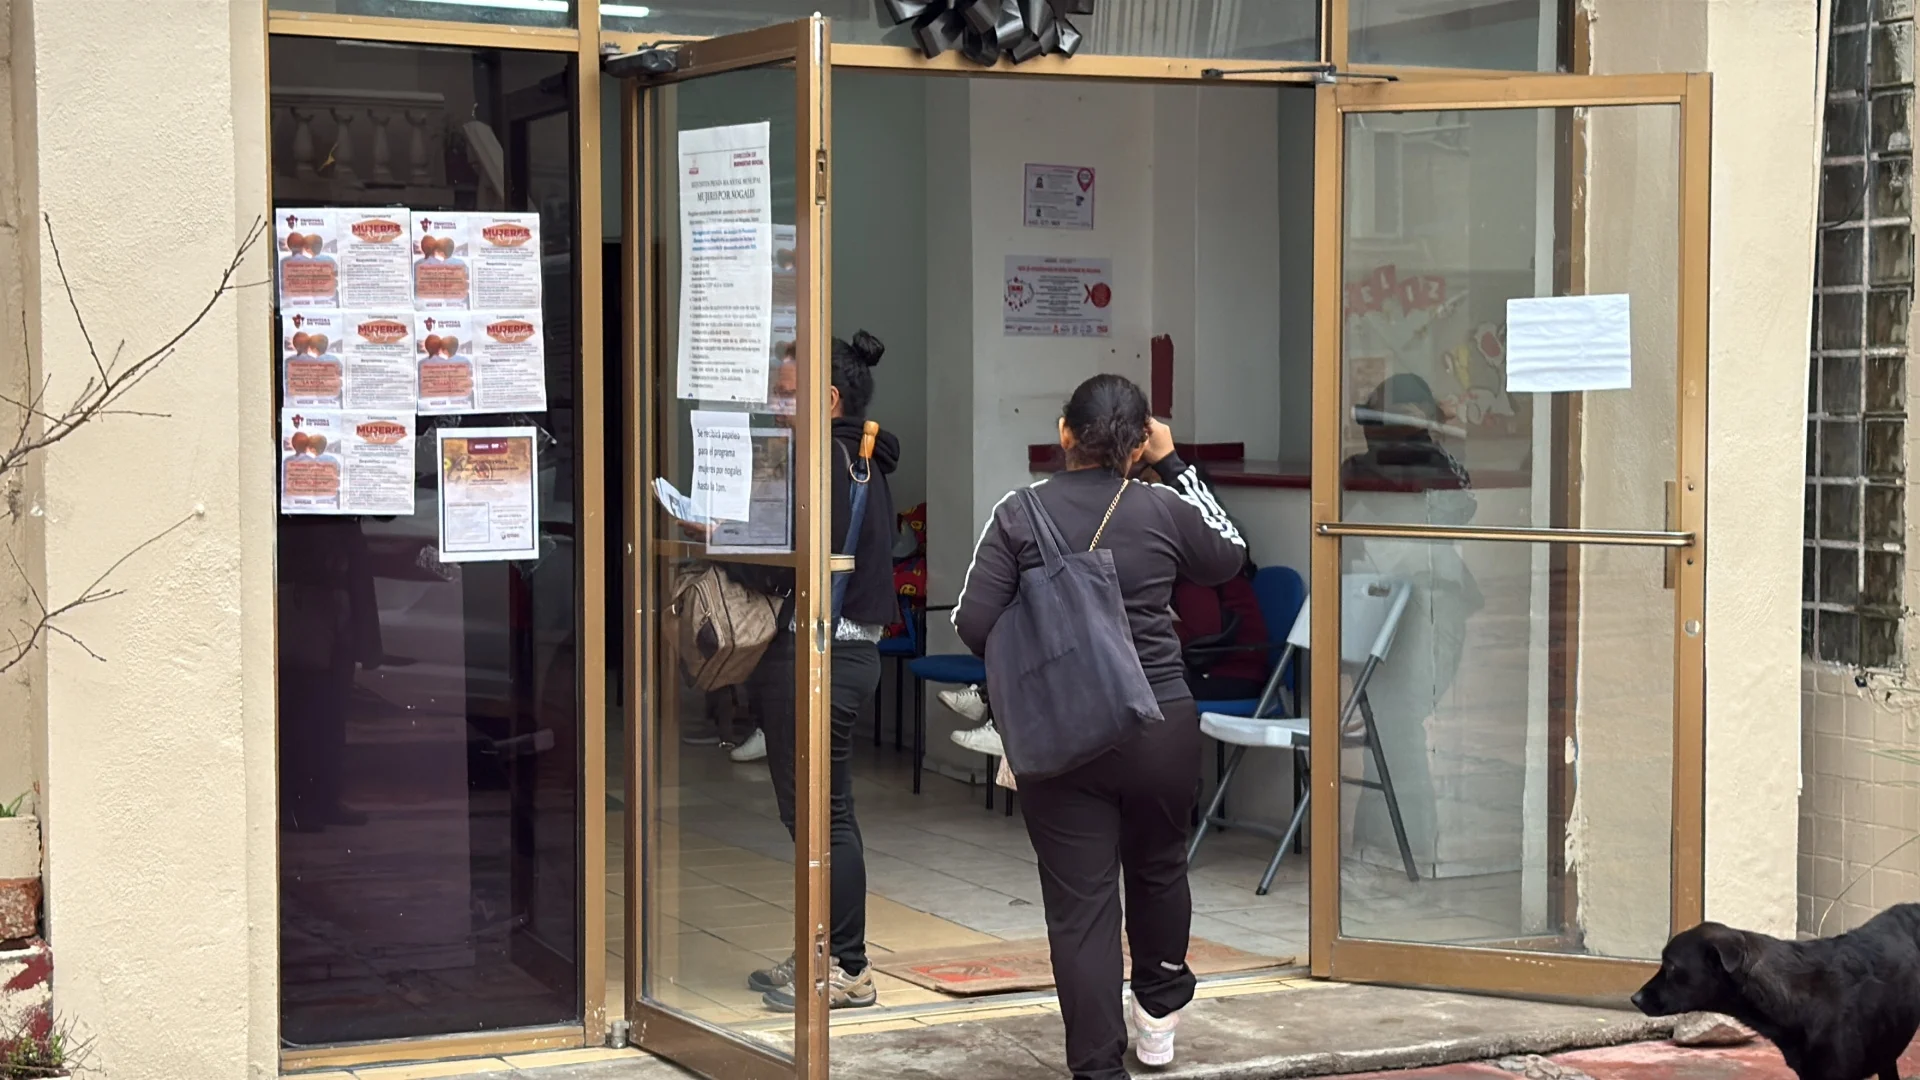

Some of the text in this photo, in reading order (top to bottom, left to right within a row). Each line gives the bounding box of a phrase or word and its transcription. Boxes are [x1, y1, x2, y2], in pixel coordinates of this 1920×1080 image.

[719, 190, 732, 201] POR
[731, 188, 755, 200] NOGALES
[351, 223, 401, 233] MUJERES
[482, 228, 530, 237] MUJERES
[357, 324, 407, 334] MUJERES
[486, 323, 534, 333] MUJERES
[356, 425, 406, 435] MUJERES
[697, 428, 703, 438] Se
[698, 446, 735, 458] para el programa
[698, 464, 742, 477] mujeres por nogales
[697, 480, 709, 491] hasta
